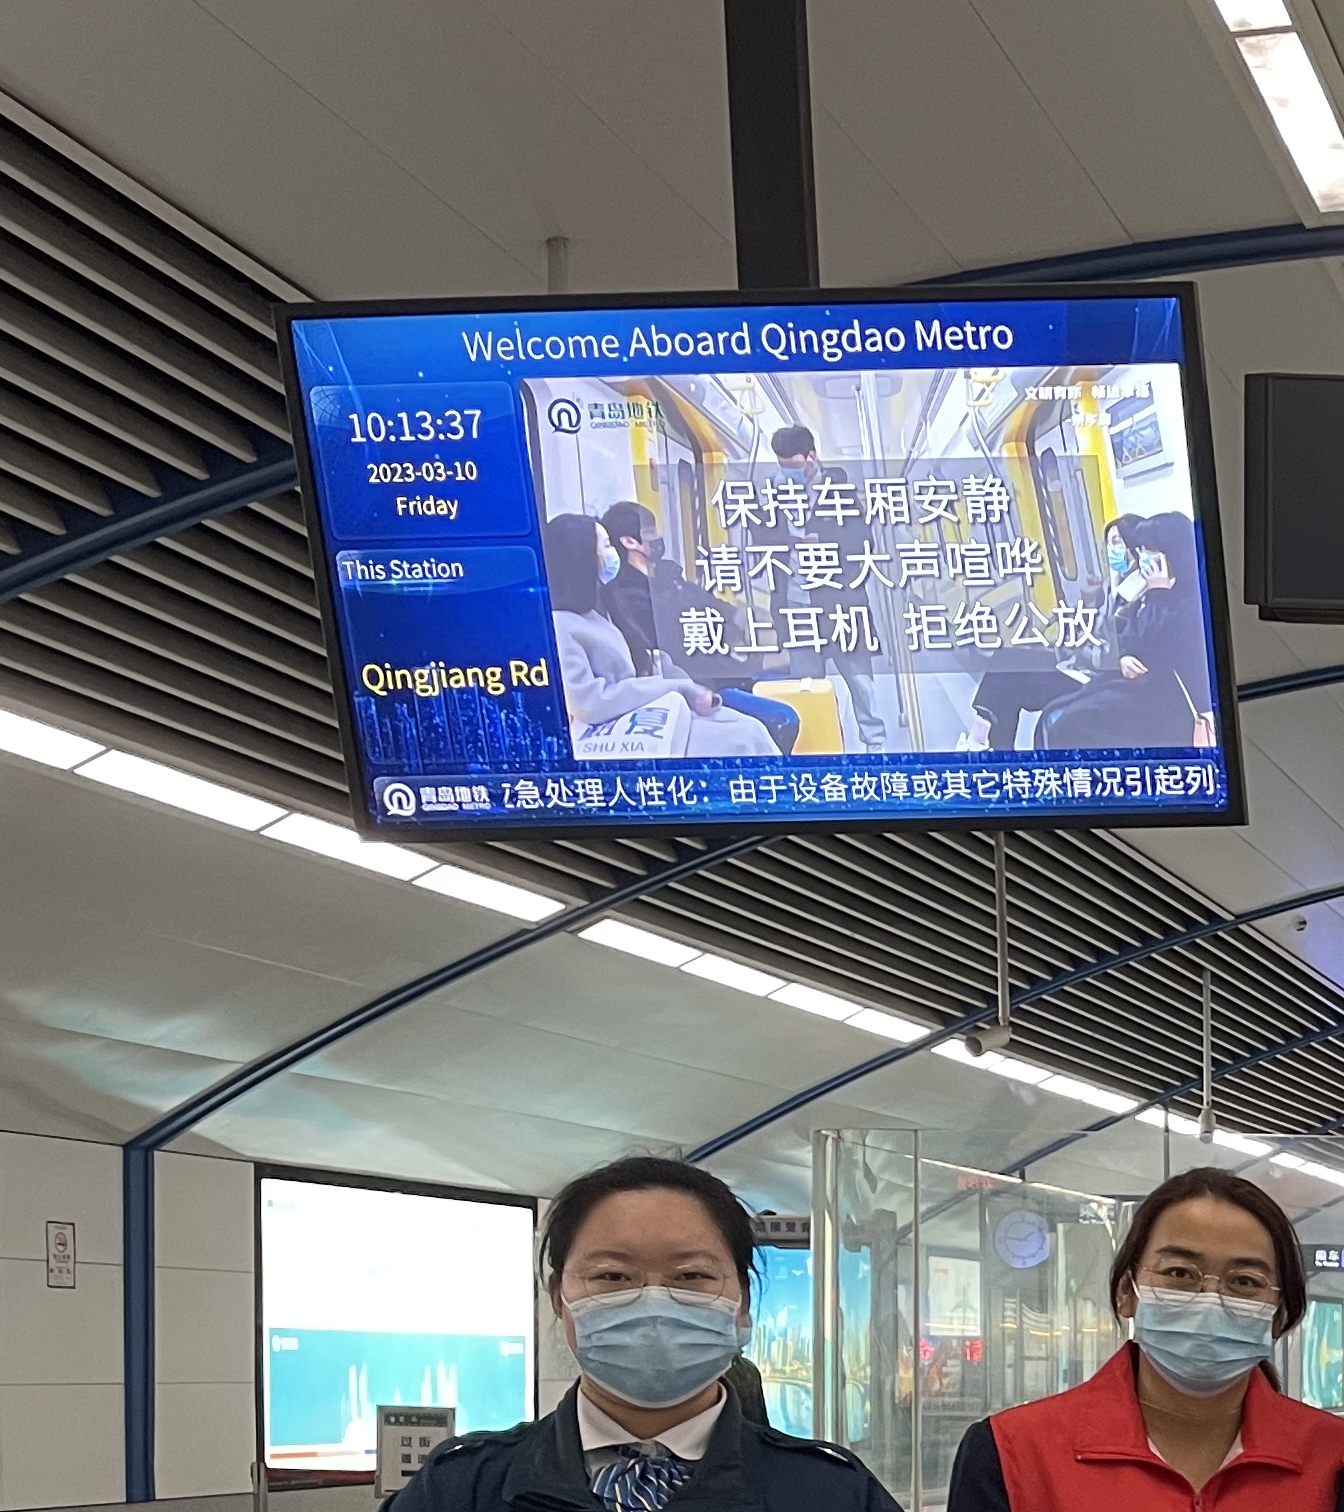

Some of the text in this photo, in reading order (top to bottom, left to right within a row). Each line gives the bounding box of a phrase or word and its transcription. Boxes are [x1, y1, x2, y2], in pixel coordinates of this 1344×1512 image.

[462, 319, 1014, 364] Welcome Aboard Qingdao Metro
[349, 408, 482, 444] 10:13:37
[588, 400, 665, 421] 青岛地铁
[367, 461, 477, 483] 2023-03-10
[396, 497, 459, 519] Friday
[711, 473, 1012, 529] 保持车厢安静
[342, 558, 465, 580] This Station
[695, 537, 1045, 594] 请不要大声喧哗
[678, 599, 1103, 657] 戴上耳机 拒绝公放
[361, 658, 550, 698] Qingjiang Rd
[583, 741, 645, 753] SHU XIA
